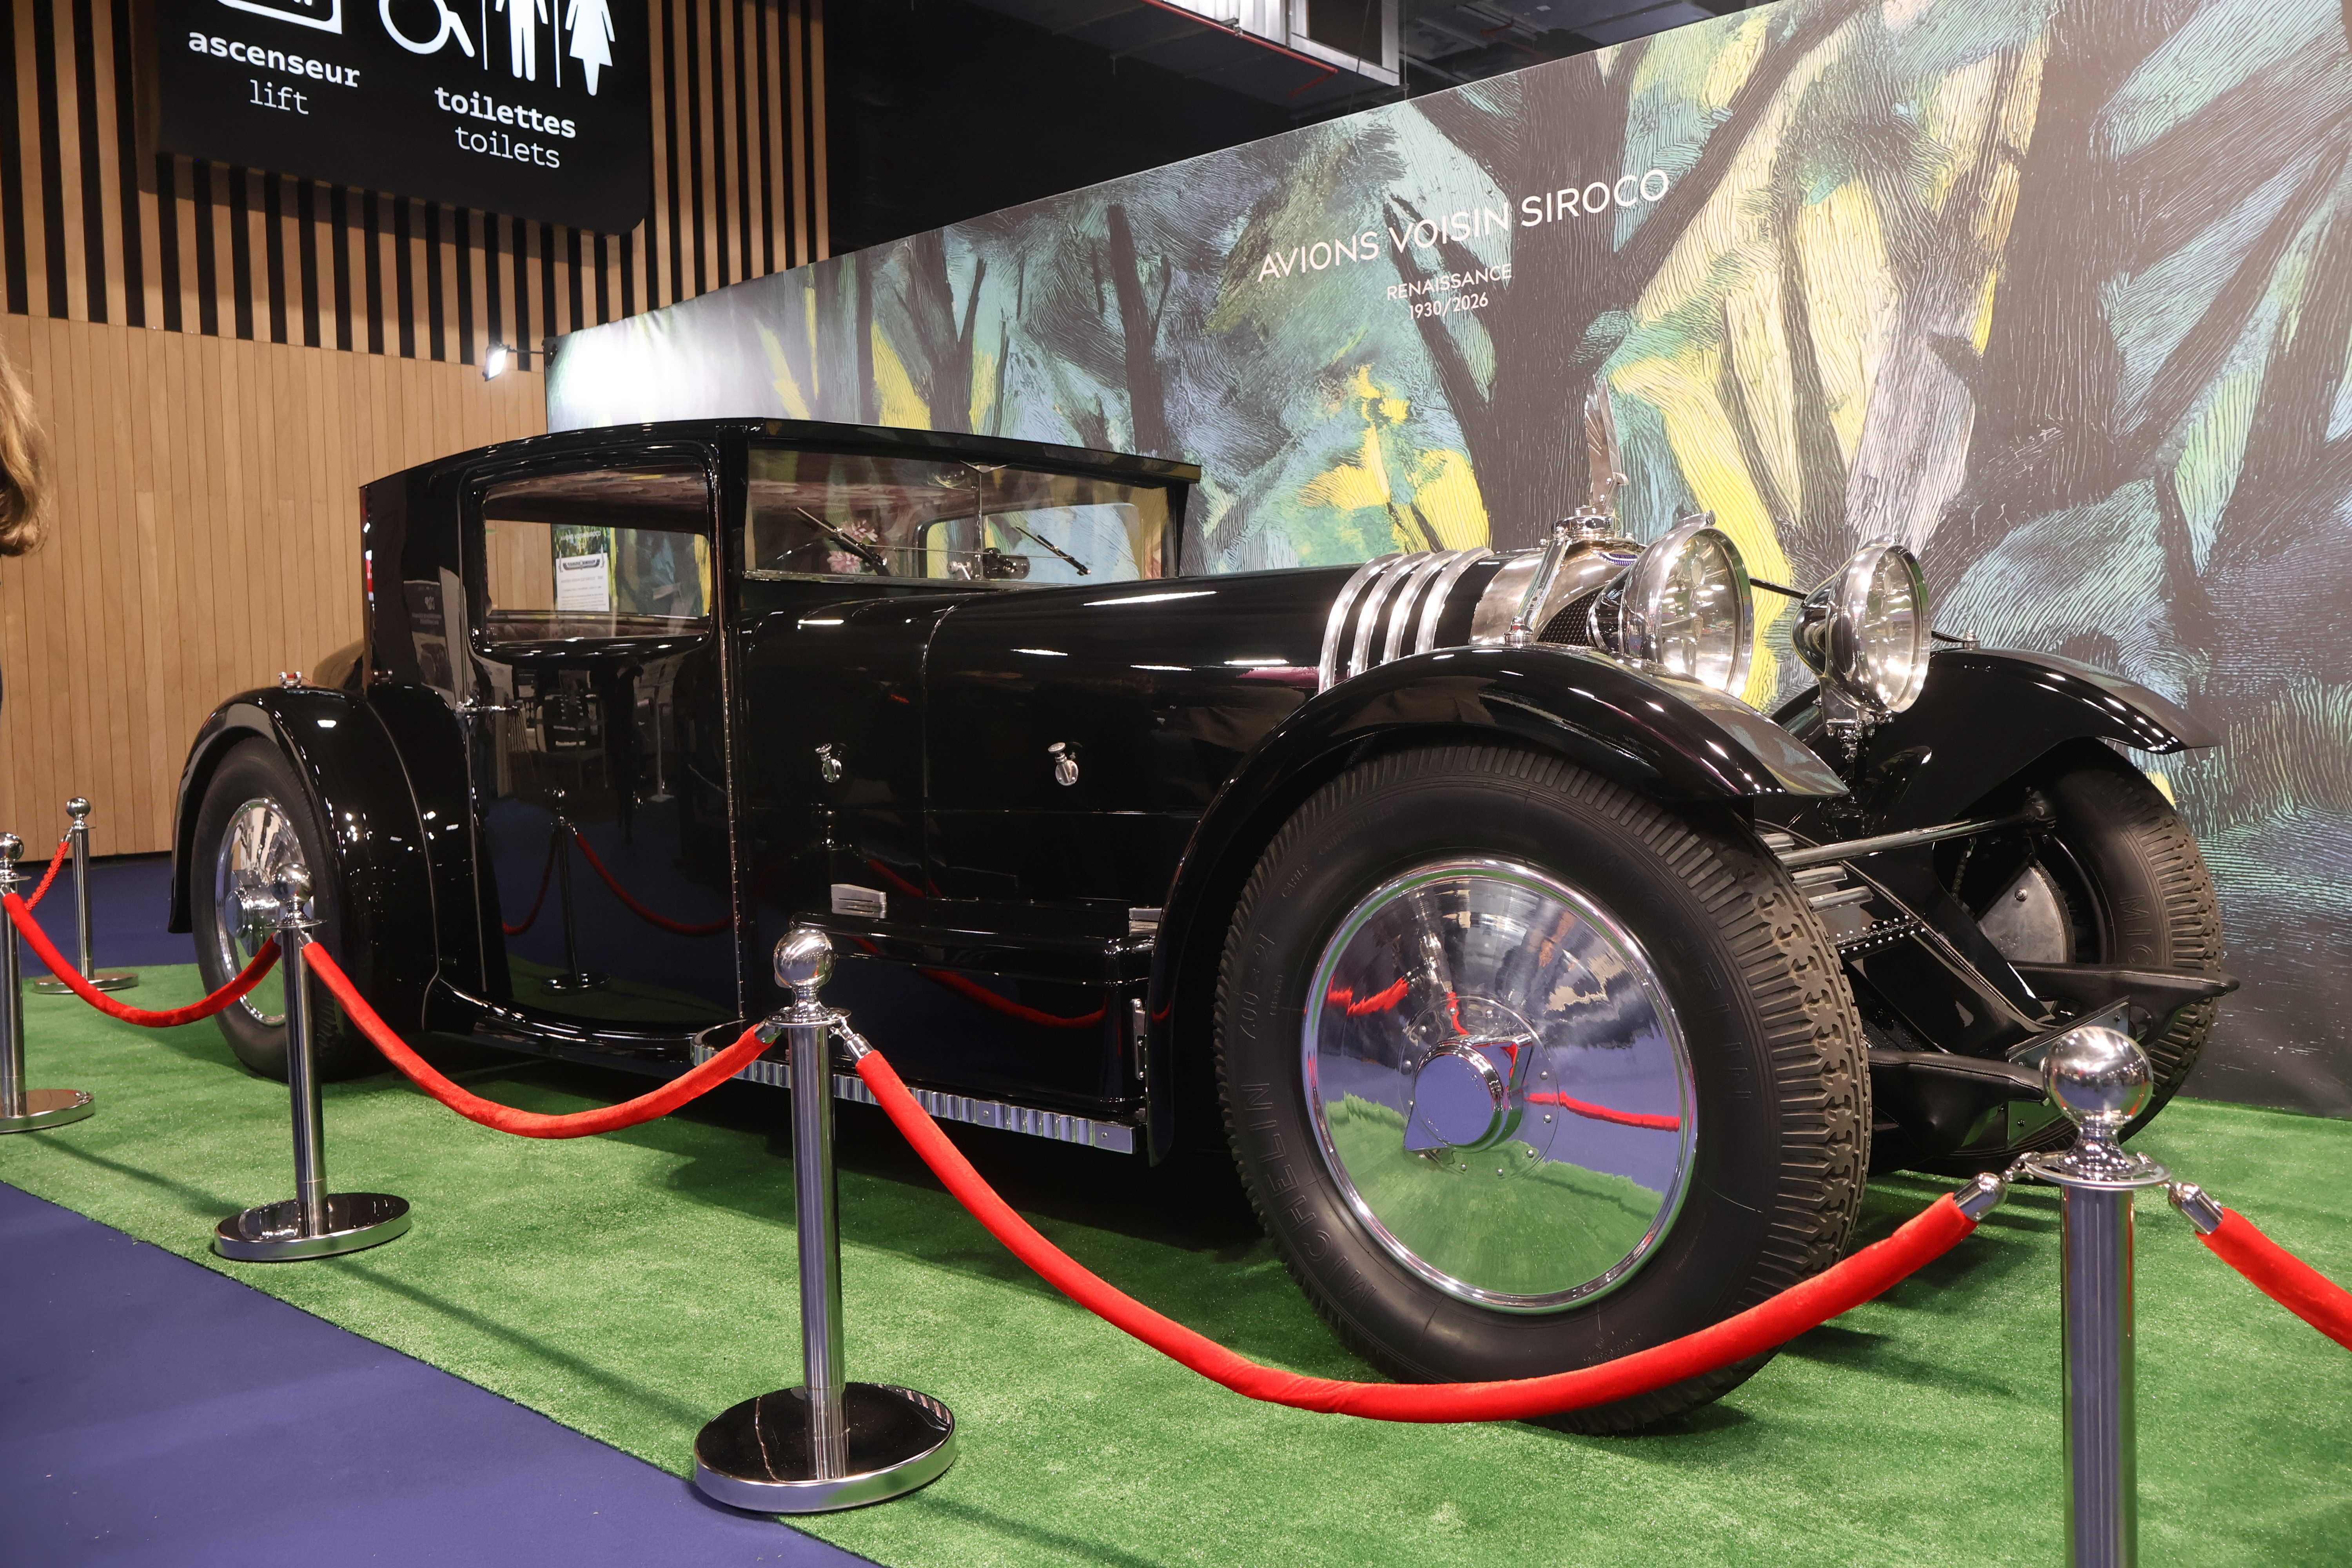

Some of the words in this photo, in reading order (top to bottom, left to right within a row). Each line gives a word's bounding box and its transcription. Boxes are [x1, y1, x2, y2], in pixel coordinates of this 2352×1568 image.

[188, 31, 360, 87] ascenseur
[250, 79, 309, 114] lift
[434, 87, 576, 138] toilettes
[455, 126, 560, 168] toilets
[1257, 232, 1379, 282] AVIONS
[1389, 203, 1508, 253] VOISIN
[1521, 169, 1669, 227] SIROCO
[1387, 263, 1512, 301] RENAISSANCE
[1409, 291, 1489, 320] 1930/2026
[1241, 1083, 1376, 1313] MICHELIN
